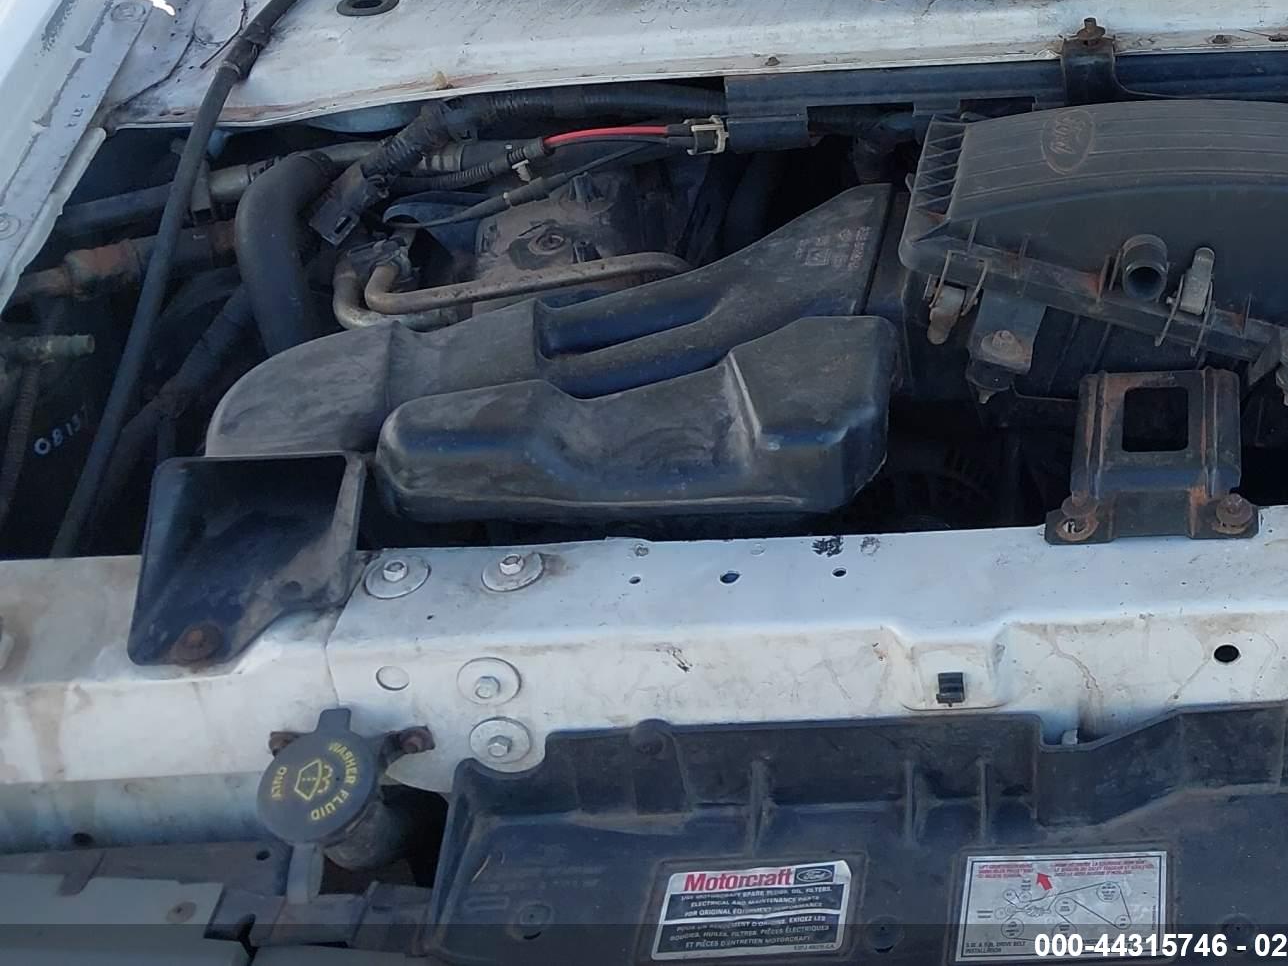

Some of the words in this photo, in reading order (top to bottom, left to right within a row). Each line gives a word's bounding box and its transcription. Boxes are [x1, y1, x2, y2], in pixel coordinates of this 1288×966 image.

[328, 742, 358, 784] WASHER
[271, 765, 288, 798] ONLY
[310, 789, 349, 821] FLUID
[684, 869, 793, 891] Motorcraft
